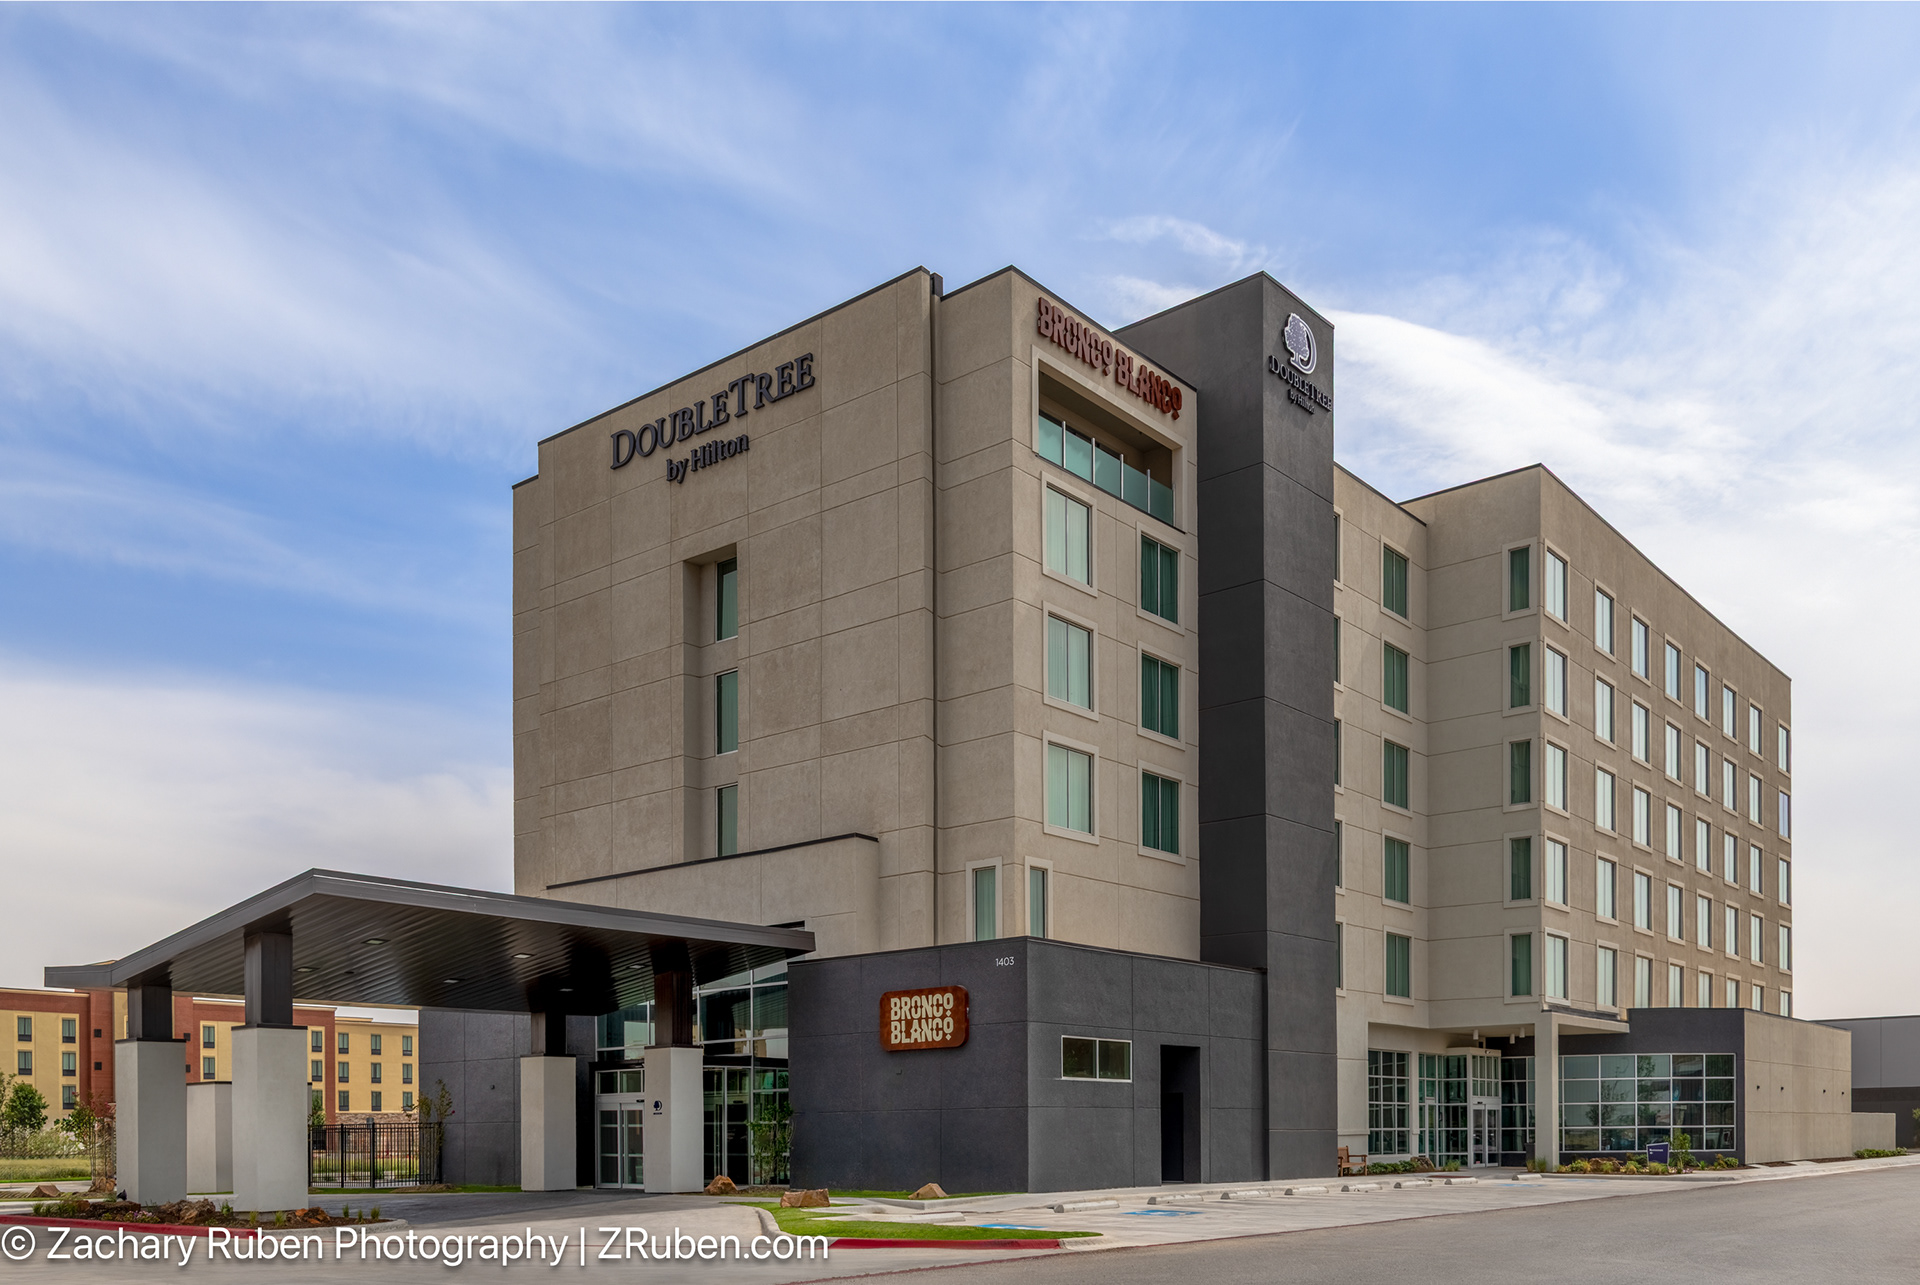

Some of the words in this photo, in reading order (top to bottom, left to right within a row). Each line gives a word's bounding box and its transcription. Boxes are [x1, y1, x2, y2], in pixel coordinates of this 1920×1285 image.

[1038, 297, 1113, 376] BRONCO
[1116, 349, 1182, 420] BLANCO
[666, 458, 688, 484] by
[690, 434, 749, 472] Hilton
[995, 956, 1015, 967] 1403
[890, 992, 954, 1021] BRONCO
[890, 1016, 954, 1044] BLANCO
